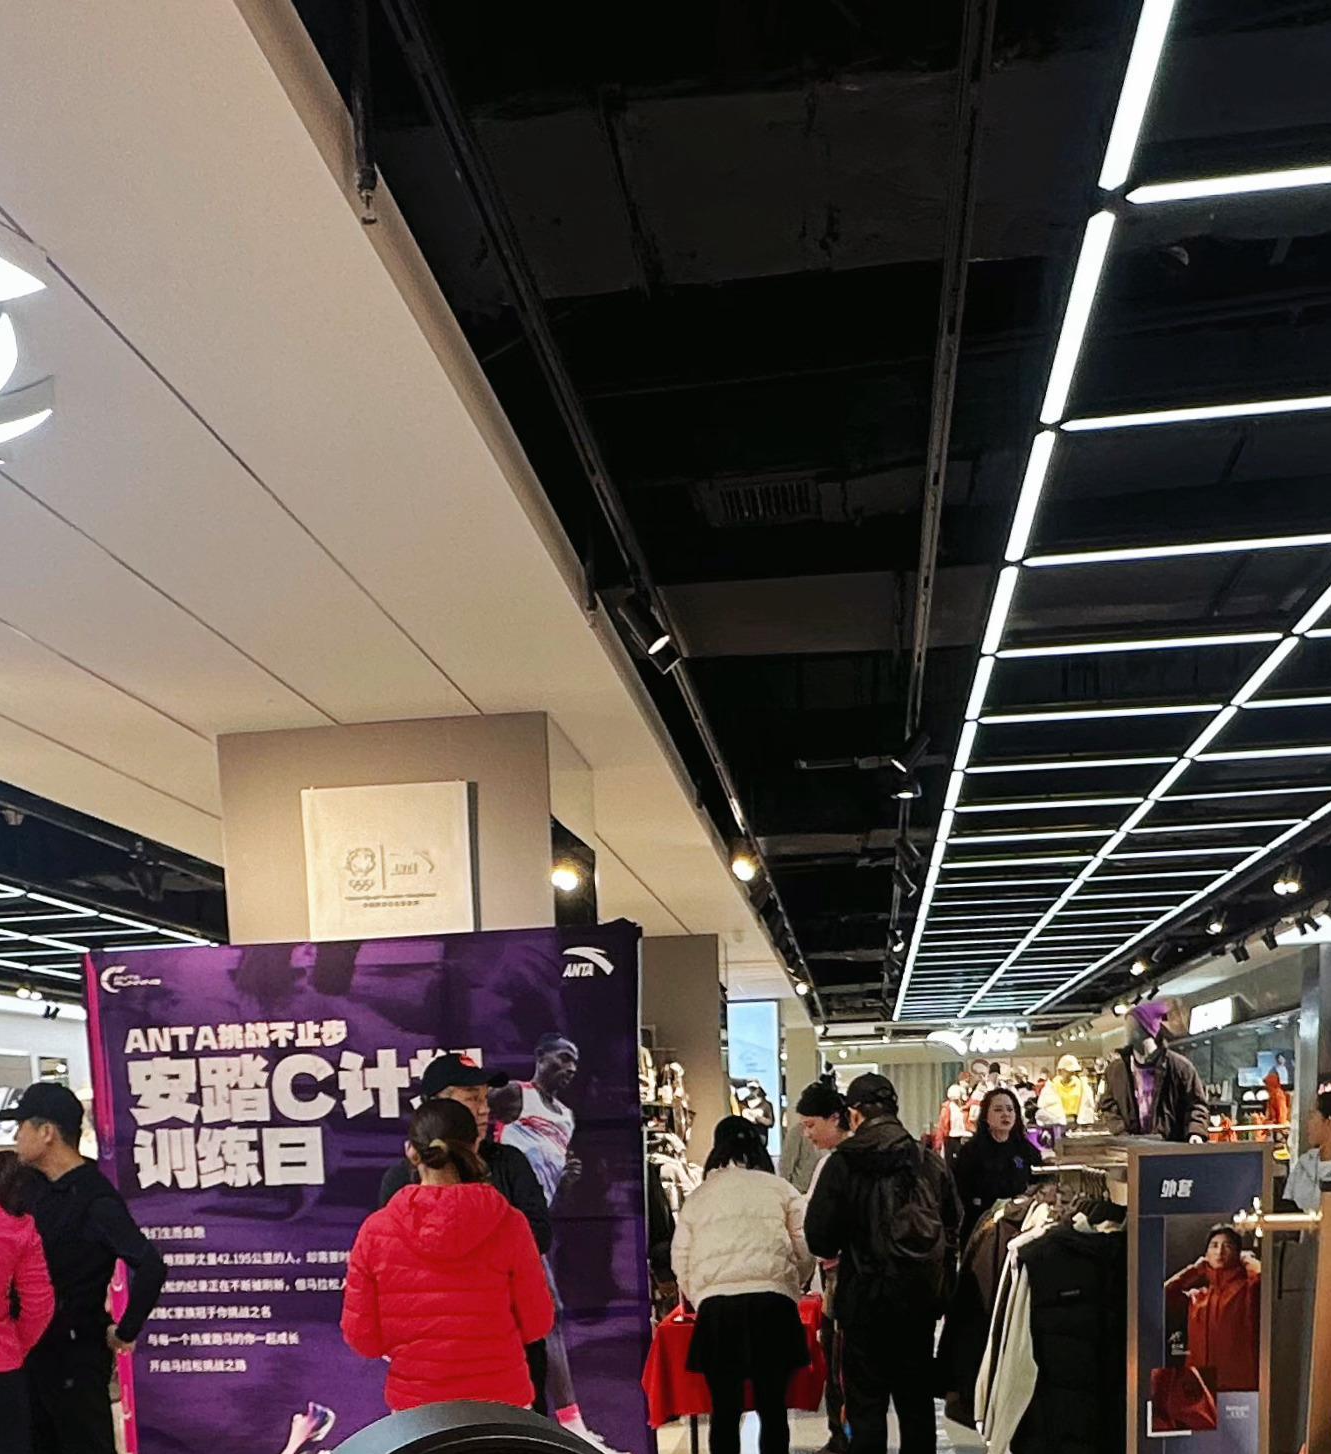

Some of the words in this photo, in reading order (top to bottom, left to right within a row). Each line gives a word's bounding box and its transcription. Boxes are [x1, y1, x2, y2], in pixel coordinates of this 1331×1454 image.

[562, 962, 594, 978] ANTA
[124, 1019, 348, 1053] ANTA挑战不止步
[133, 1126, 325, 1191] 训练日
